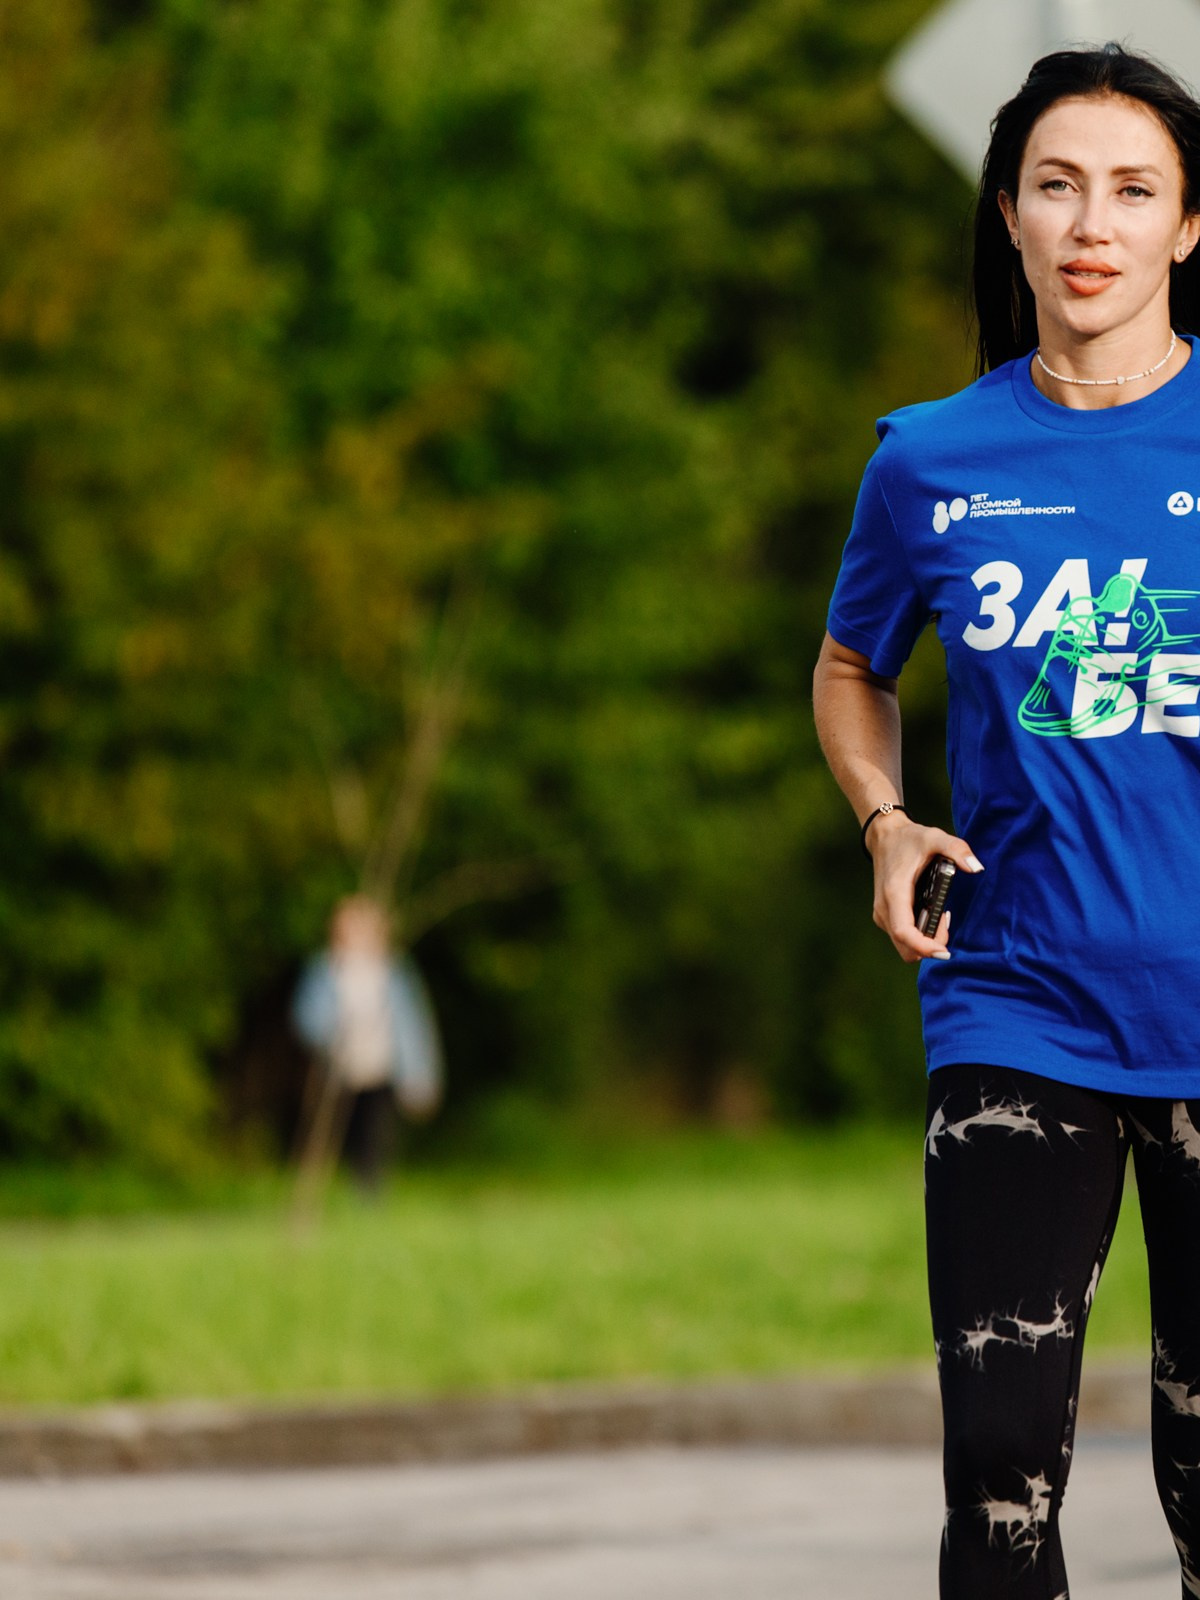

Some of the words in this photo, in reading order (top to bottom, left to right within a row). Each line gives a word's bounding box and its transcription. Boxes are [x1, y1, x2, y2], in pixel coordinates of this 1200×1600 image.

[970, 498, 1021, 511] АТОМНОЙ
[970, 506, 1076, 518] ПРОМЫШЛЕННОСТИ
[962, 558, 1148, 651] ЗА!
